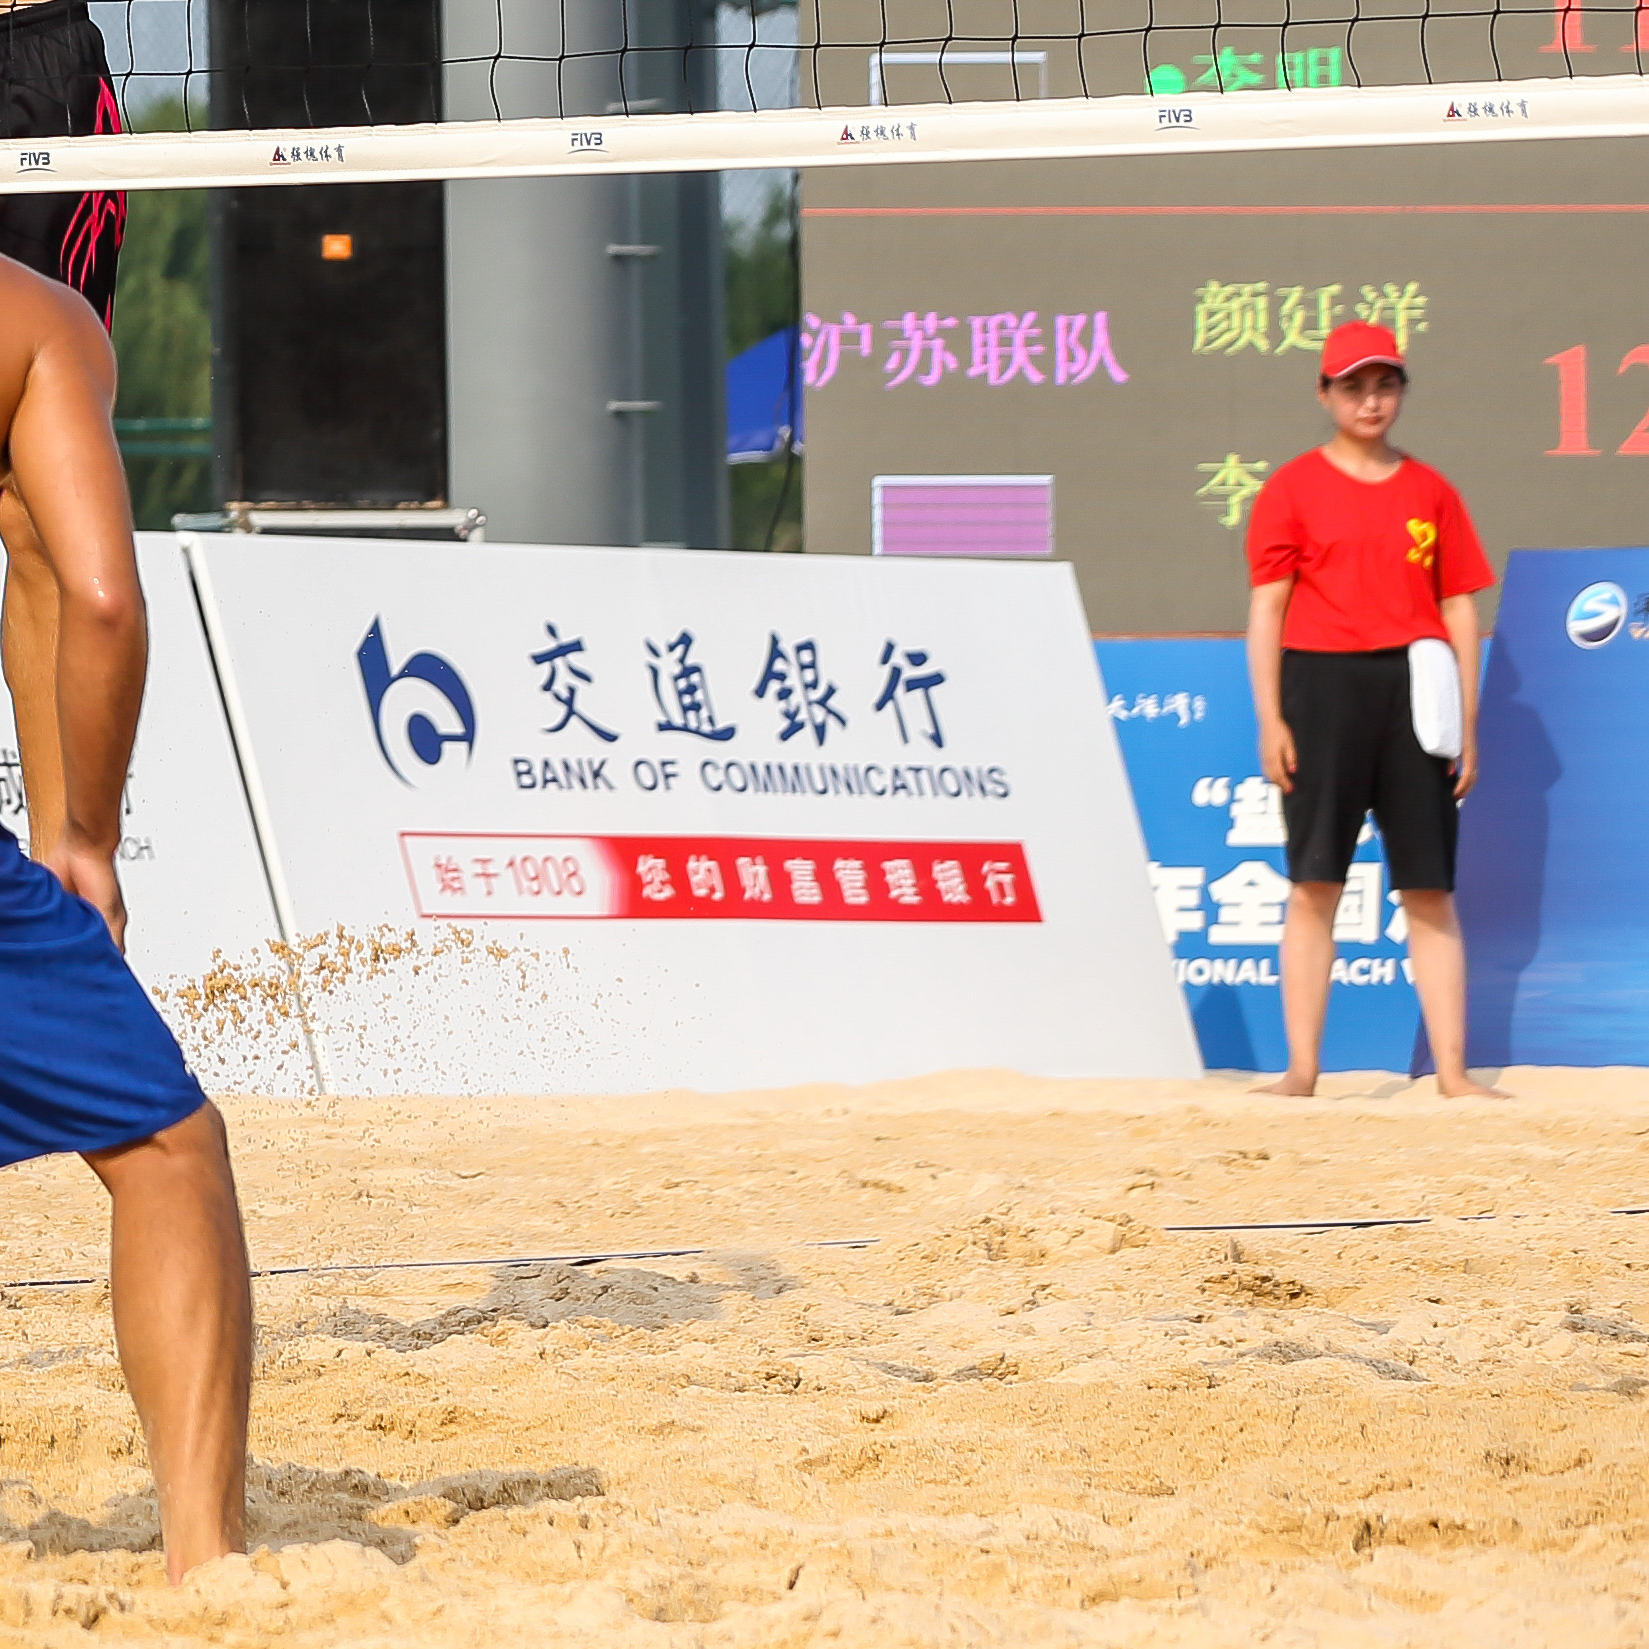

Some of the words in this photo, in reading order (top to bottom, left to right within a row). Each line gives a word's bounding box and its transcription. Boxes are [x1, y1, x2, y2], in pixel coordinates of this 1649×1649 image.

[1158, 109, 1193, 124] FIVB
[571, 132, 603, 146] FIVB
[20, 152, 50, 166] FIVB
[799, 311, 1130, 390] 沪苏联队
[530, 621, 946, 748] 交通銀行
[512, 757, 615, 792] BANK
[631, 758, 682, 791] OF
[700, 760, 1011, 800] COMMUNICATIONS
[1171, 958, 1280, 987] IONAL
